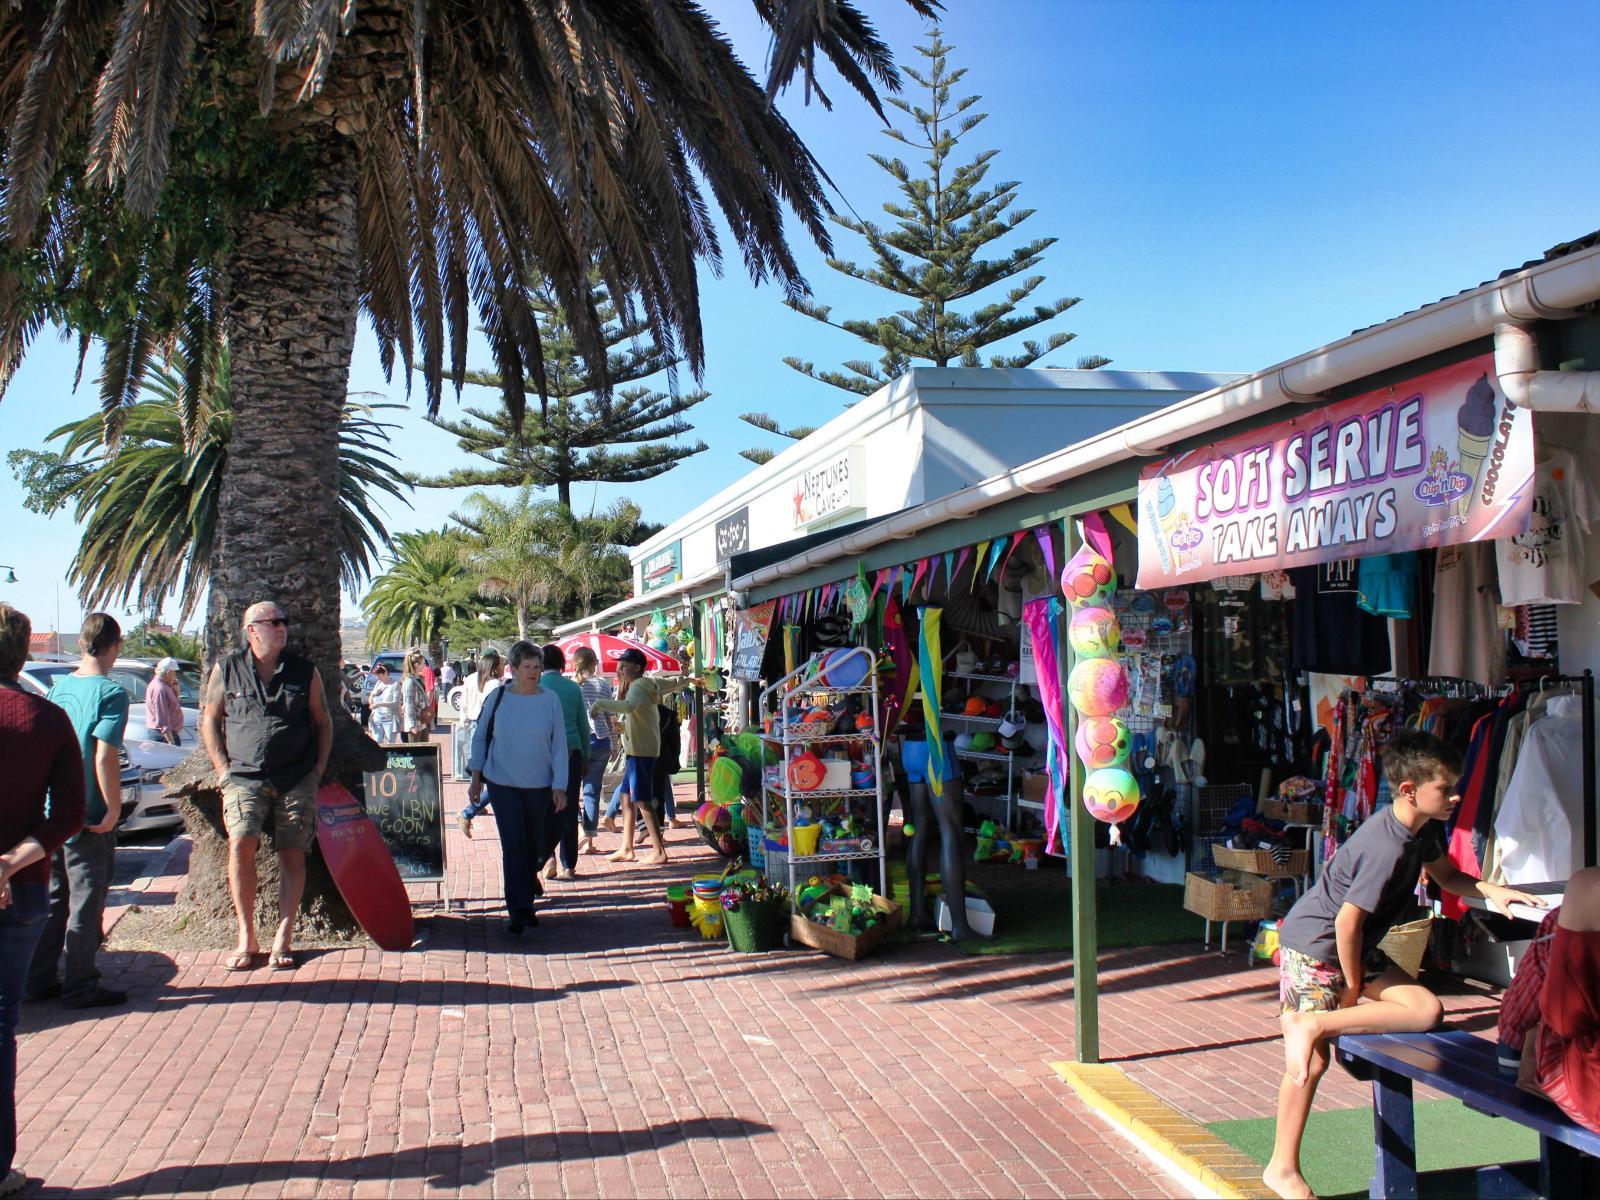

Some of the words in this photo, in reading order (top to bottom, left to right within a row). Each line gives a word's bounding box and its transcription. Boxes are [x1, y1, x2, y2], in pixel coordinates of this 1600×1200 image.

[1197, 446, 1272, 520] SOFT
[1284, 397, 1423, 500] SERVE
[804, 458, 849, 500] NEPTUNES
[1212, 513, 1279, 565] TAKE
[1285, 488, 1397, 554] AWAYS
[371, 771, 397, 797] 10
[407, 769, 418, 793] %
[362, 803, 389, 816] ave
[402, 799, 435, 823] LBN
[380, 818, 425, 834] GOON
